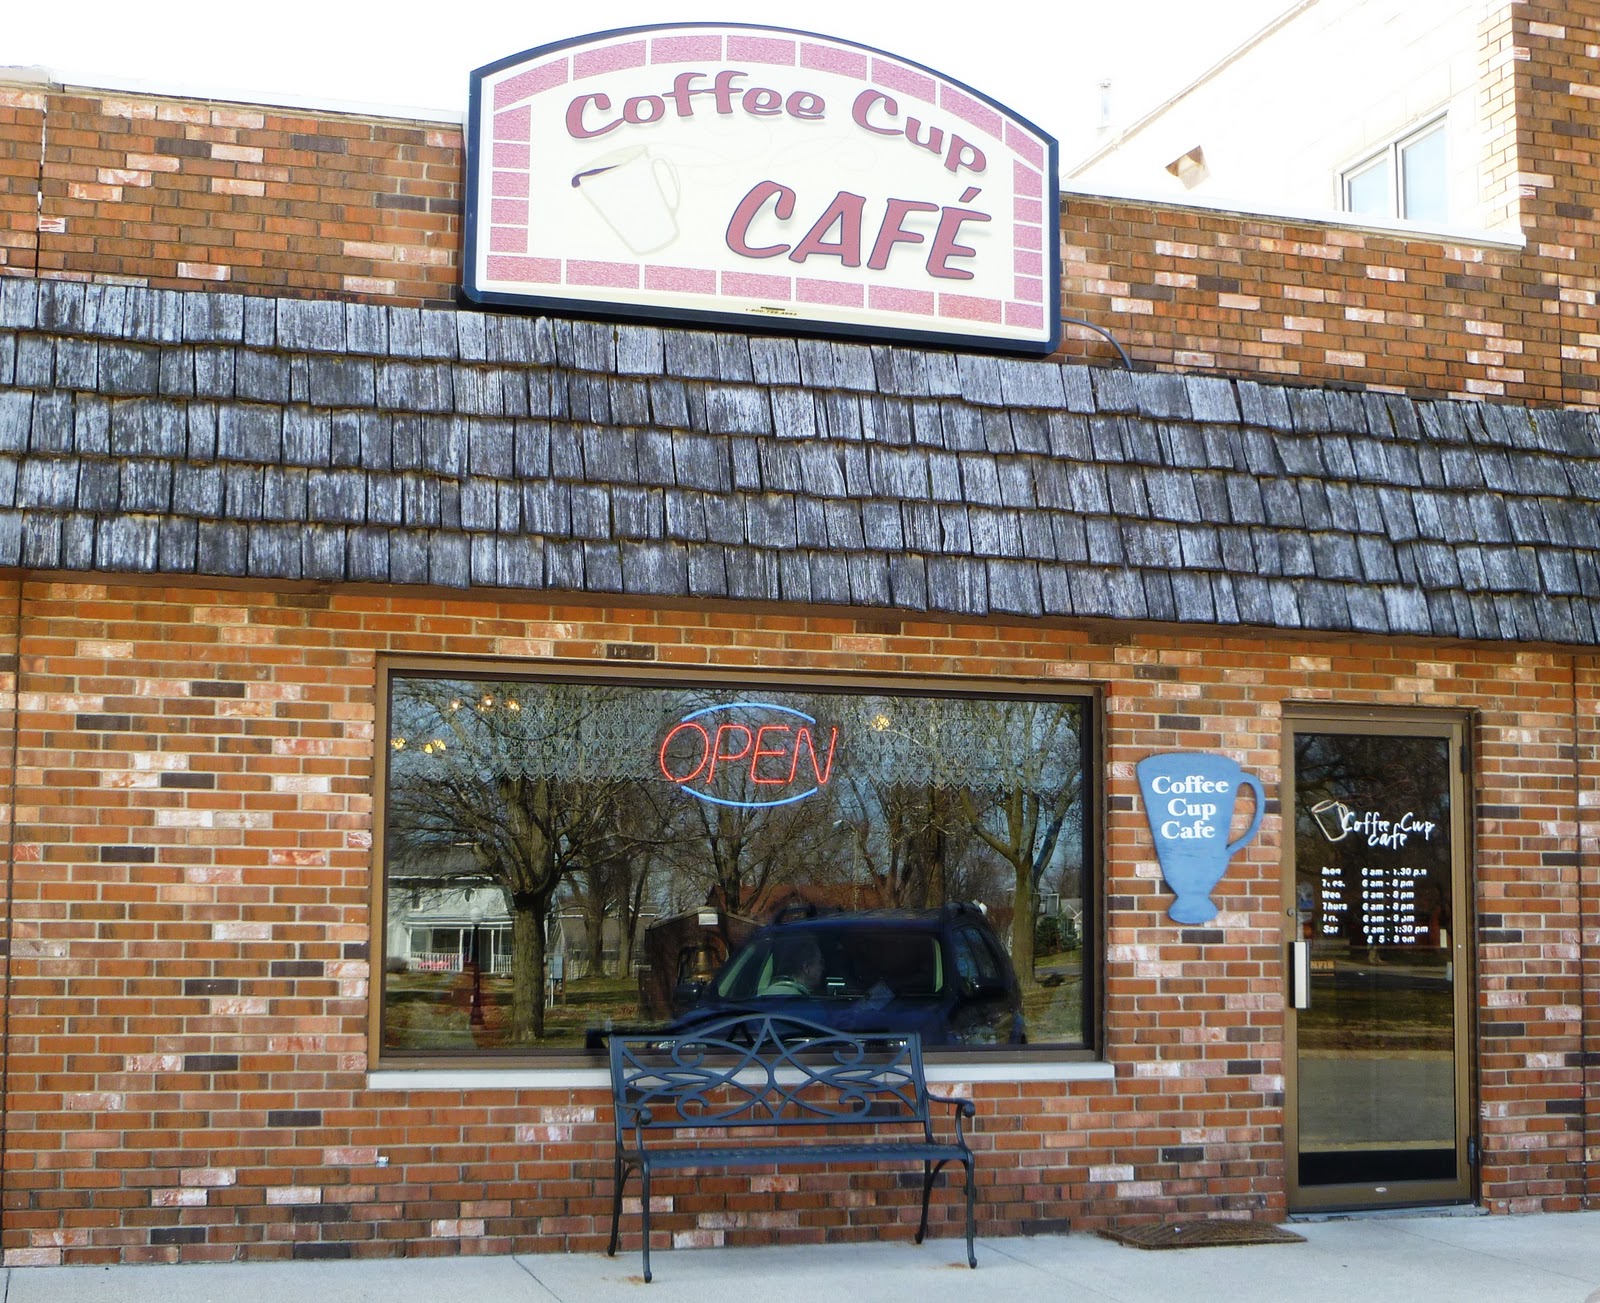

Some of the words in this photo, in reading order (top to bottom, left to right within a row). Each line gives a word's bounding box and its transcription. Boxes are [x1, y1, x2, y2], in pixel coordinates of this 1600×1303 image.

[565, 70, 827, 140] Coffee
[851, 88, 988, 175] Cup
[724, 180, 993, 281] CAFÉ
[660, 721, 839, 785] OPEN
[1151, 775, 1229, 795] Coffee
[1167, 797, 1217, 821] Cup
[1160, 820, 1216, 840] Cafe
[1341, 811, 1390, 836] Coffee
[1400, 811, 1436, 841] Cup
[1362, 867, 1369, 875] 6
[1362, 879, 1369, 887] 6
[1392, 879, 1399, 887] 8
[1400, 880, 1415, 889] pm
[1362, 890, 1369, 898] 6
[1392, 891, 1399, 899] 8
[1400, 892, 1415, 901] pm
[1362, 902, 1369, 910] 6
[1392, 902, 1399, 911] 8
[1400, 903, 1415, 912] pm
[1362, 913, 1369, 922] 6
[1370, 914, 1384, 922] am
[1393, 914, 1400, 922] 9
[1362, 925, 1369, 933] 6
[1415, 926, 1429, 935] pm
[1378, 935, 1385, 943] 5
[1393, 935, 1400, 943] 9
